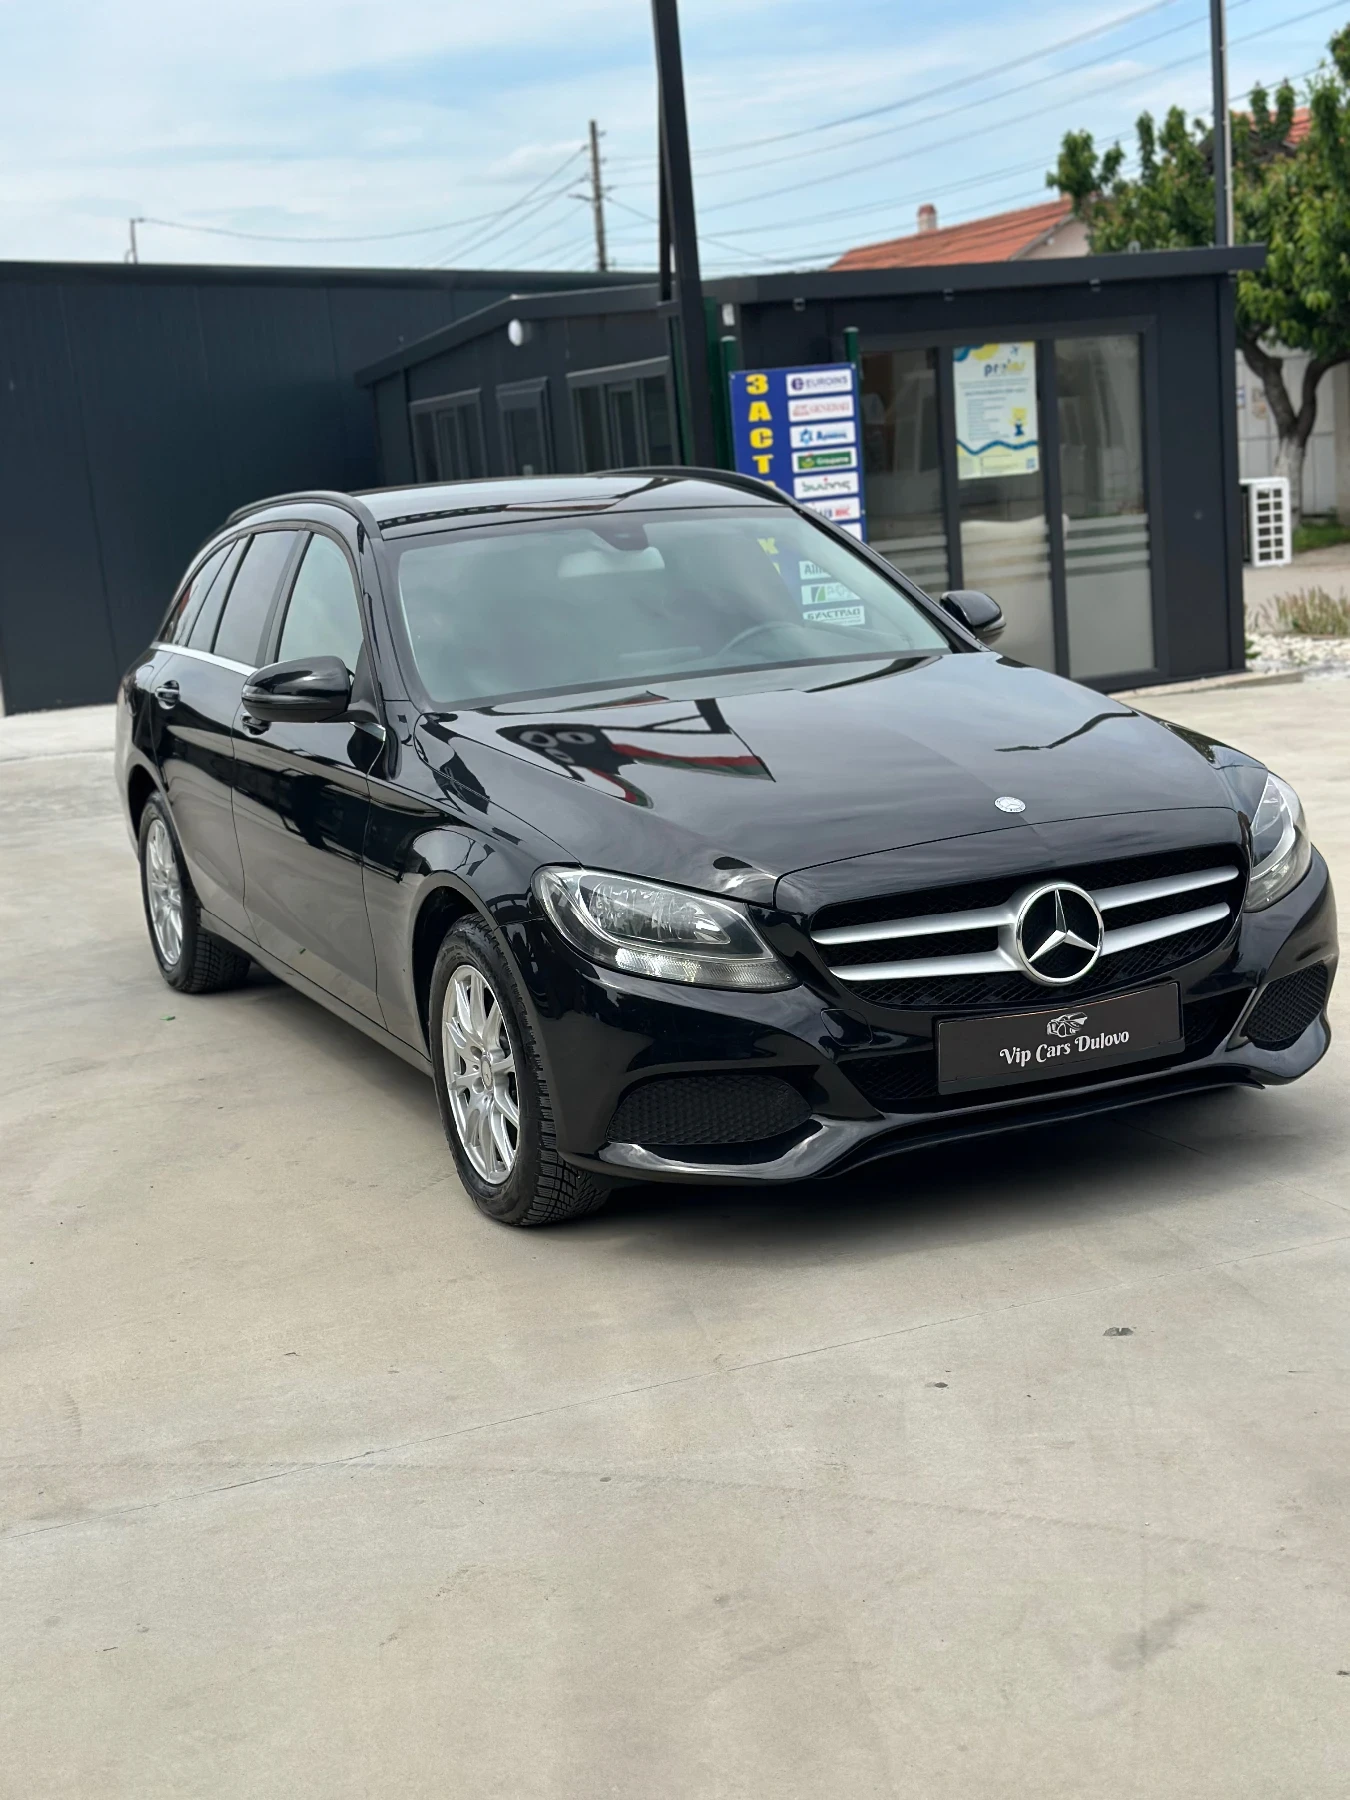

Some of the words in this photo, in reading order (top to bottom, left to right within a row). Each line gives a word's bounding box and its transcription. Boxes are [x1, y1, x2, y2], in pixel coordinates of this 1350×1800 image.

[806, 376, 848, 389] EUROINS
[999, 1048, 1031, 1067] Vip
[1035, 1041, 1071, 1063] Cars
[1074, 1030, 1129, 1052] Dulovo
